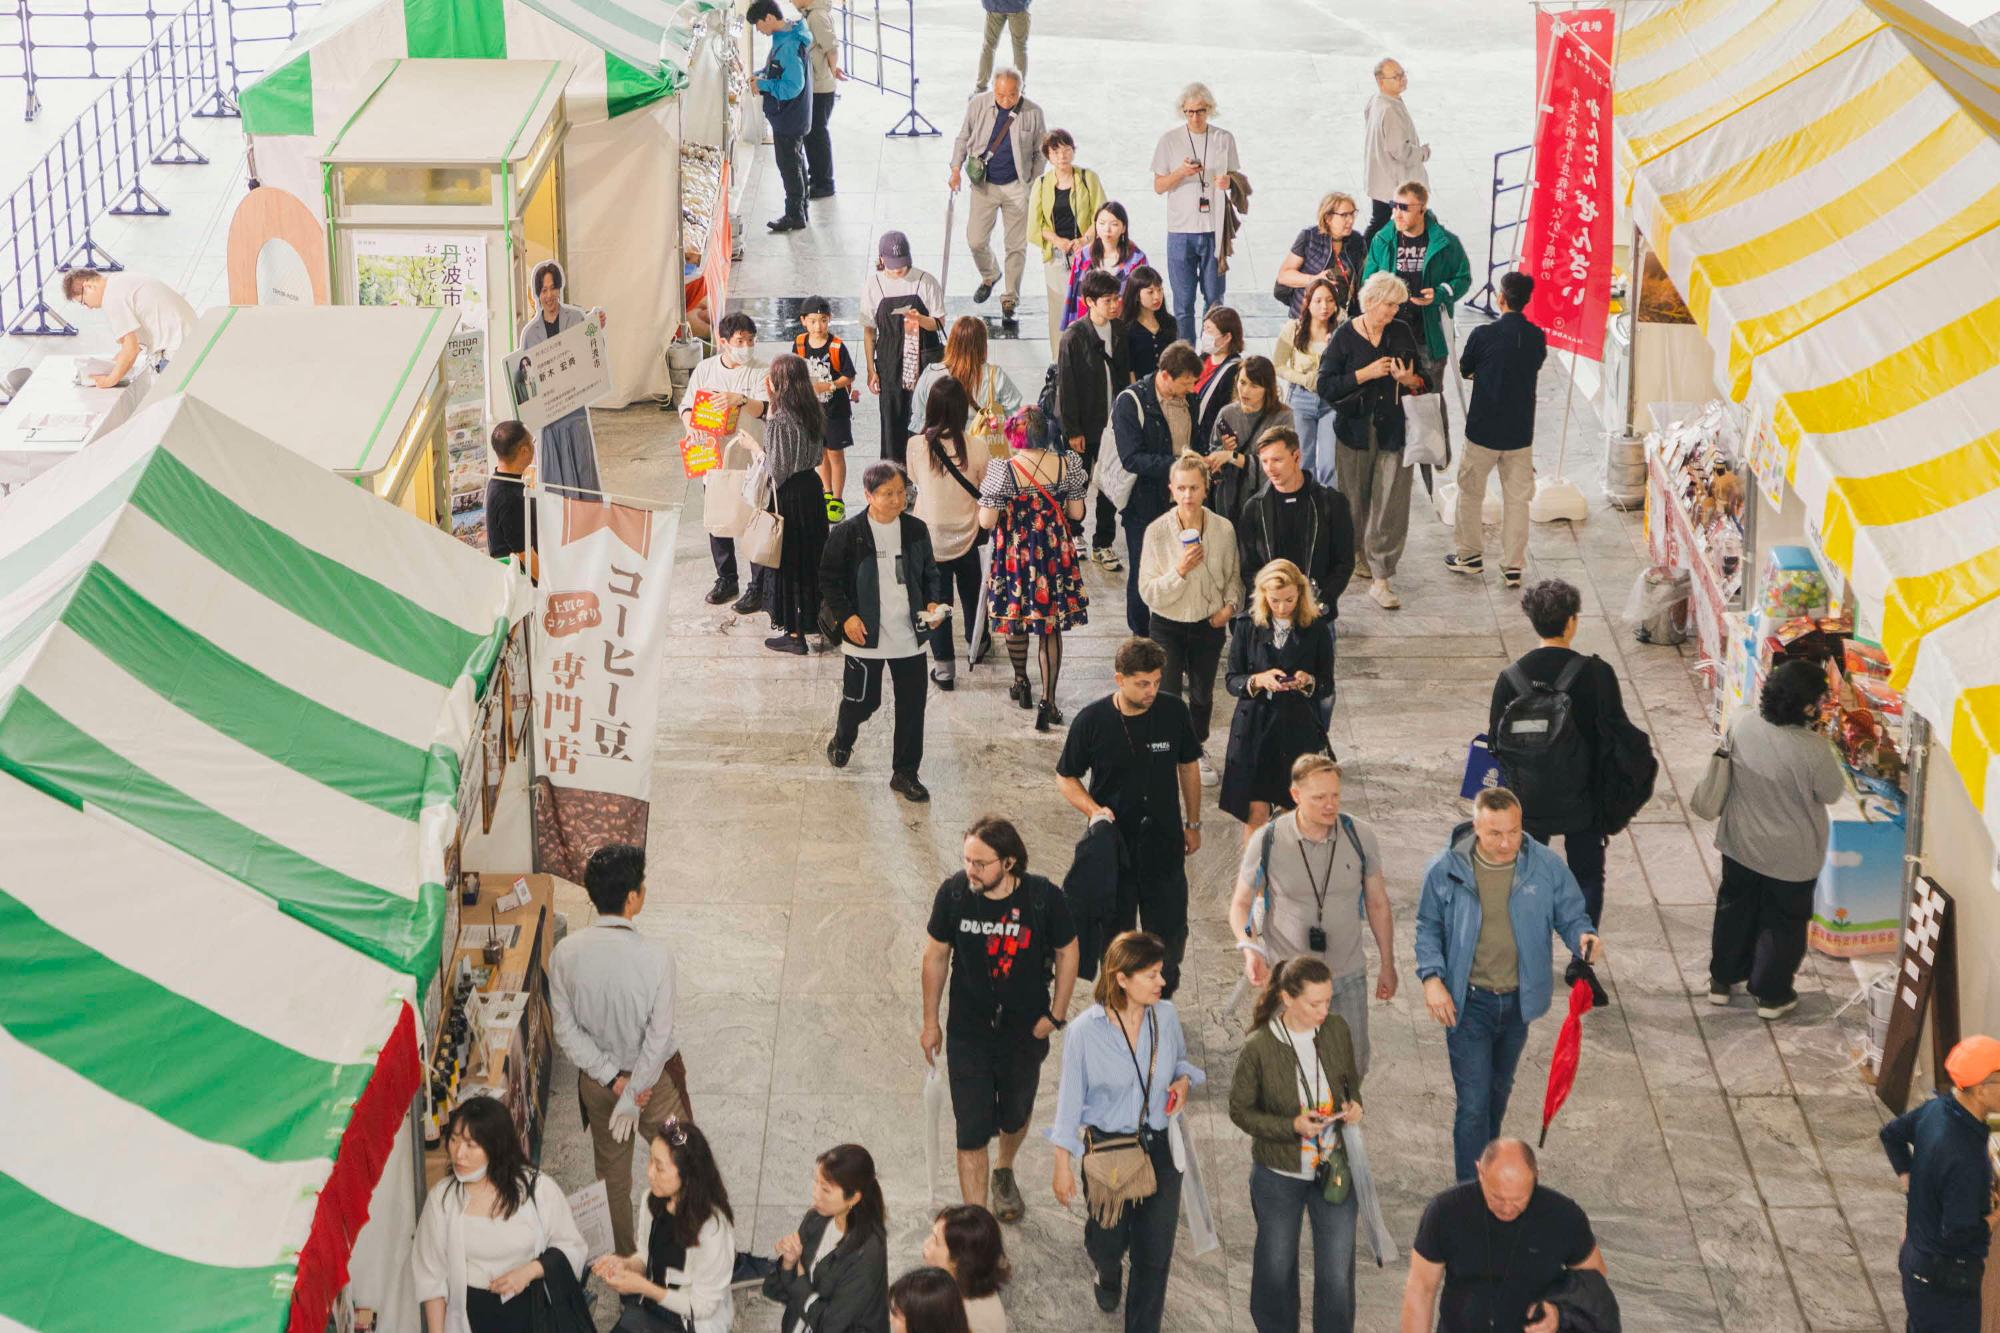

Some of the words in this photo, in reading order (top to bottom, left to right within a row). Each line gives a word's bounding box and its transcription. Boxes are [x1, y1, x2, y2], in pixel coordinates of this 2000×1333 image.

[425, 243, 438, 305] おもてなし
[441, 244, 462, 306] 丹波市
[465, 244, 476, 280] いやし
[452, 346, 473, 357] CITY
[547, 608, 598, 629] コクと香り
[586, 563, 644, 763] コーヒー豆
[543, 651, 588, 775] 専門店
[959, 919, 1021, 937] DUCATI
